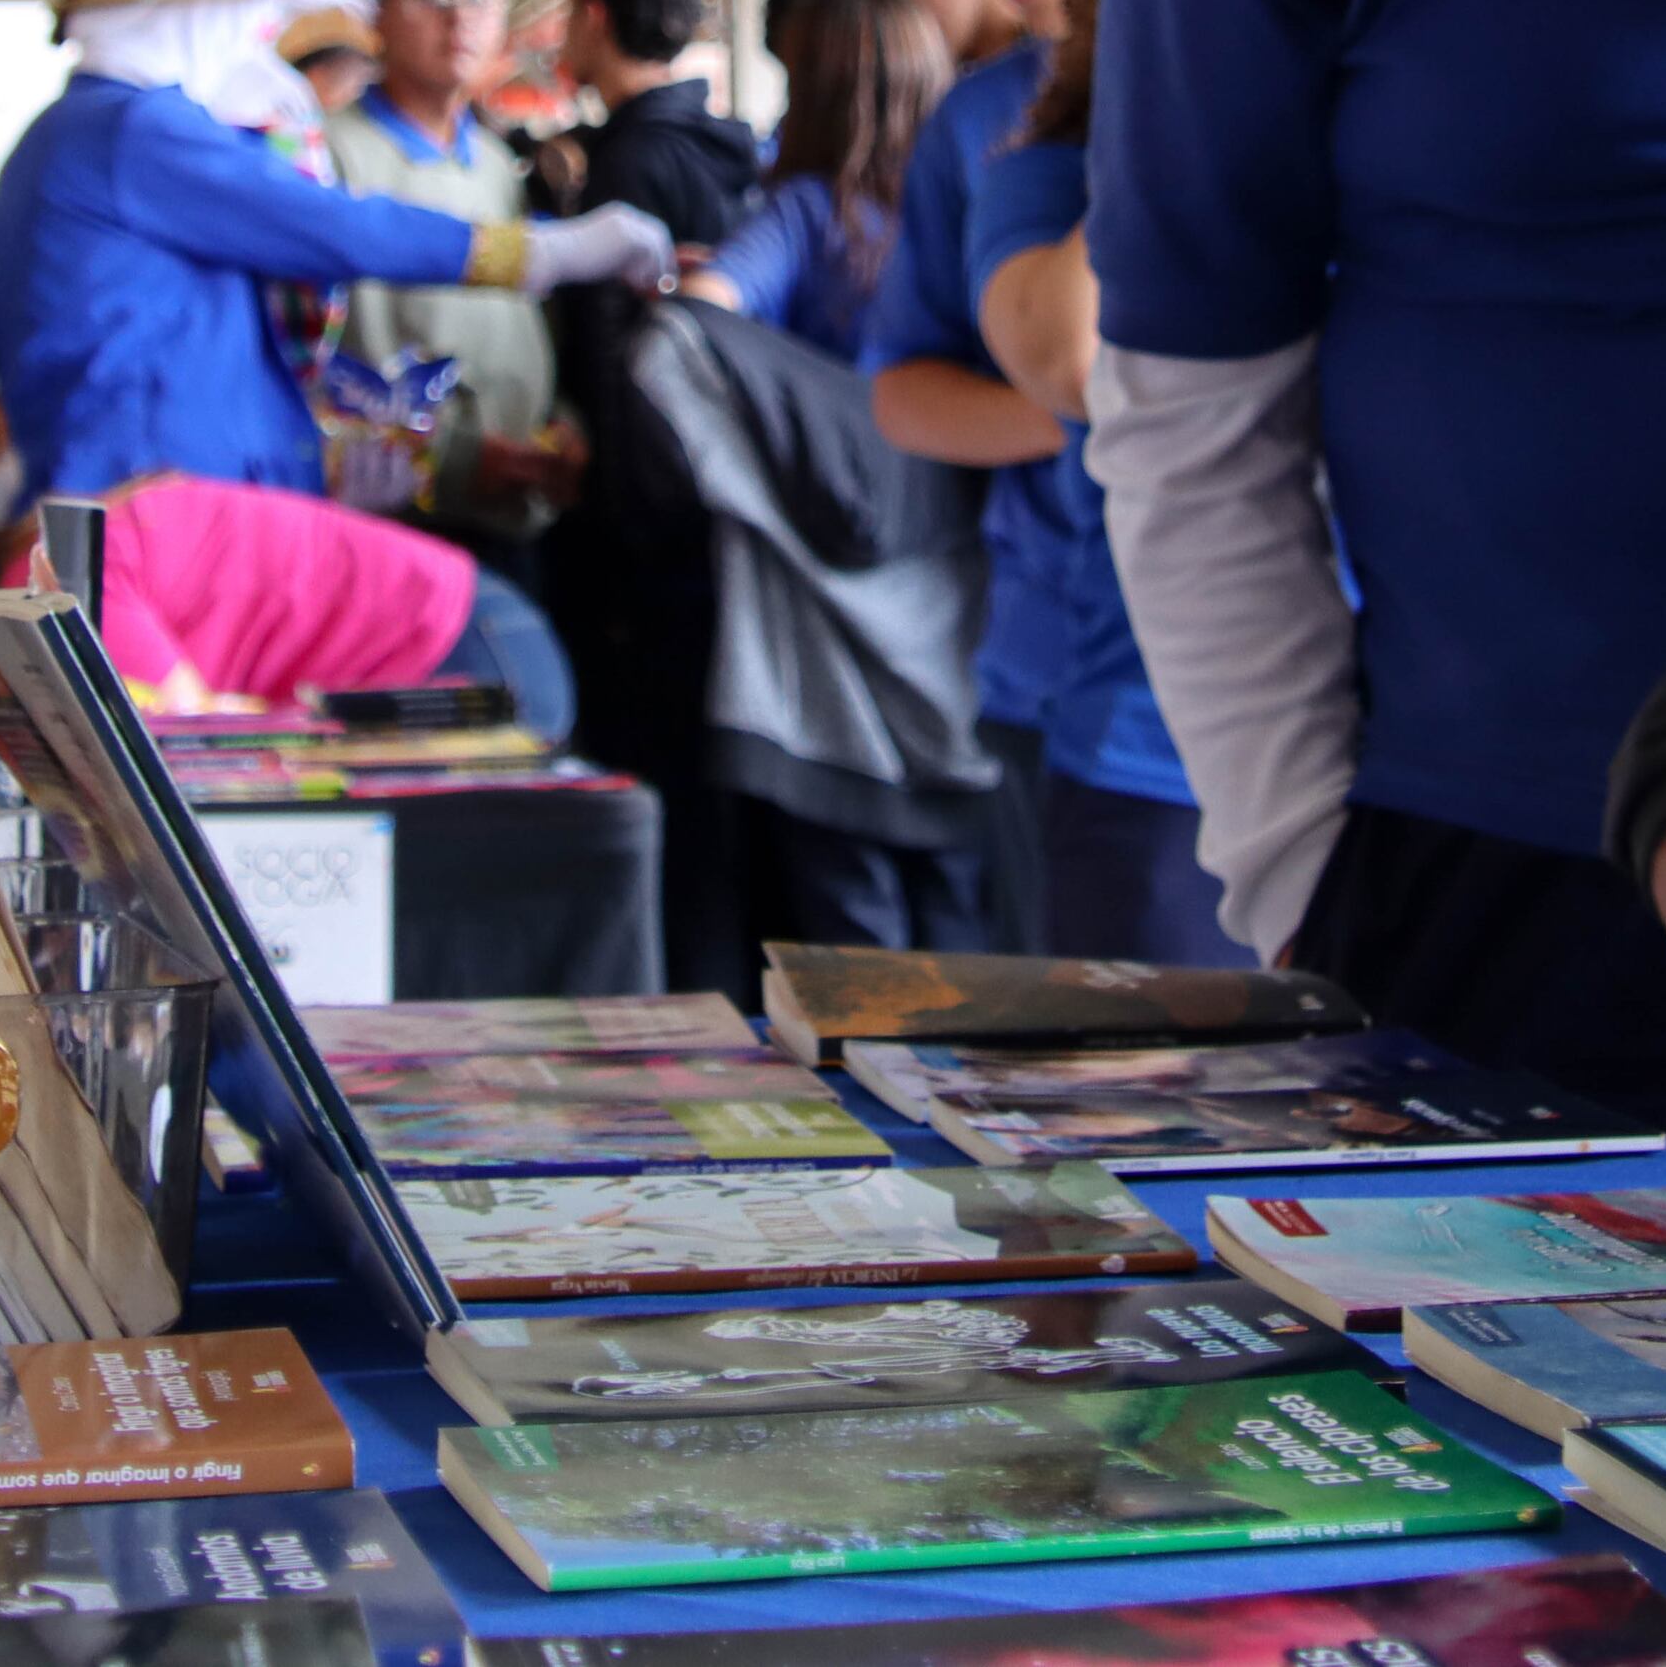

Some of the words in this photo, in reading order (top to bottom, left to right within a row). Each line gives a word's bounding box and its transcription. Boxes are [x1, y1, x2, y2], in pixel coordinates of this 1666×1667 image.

[89, 1352, 140, 1396] imaginar
[142, 1348, 191, 1376] tigres
[153, 1375, 199, 1408] somos
[104, 1405, 159, 1432] Fingir
[172, 1408, 219, 1430] que
[1267, 1393, 1379, 1455] cipreses
[1232, 1419, 1341, 1471] silencio
[43, 1465, 80, 1487] que
[85, 1463, 170, 1489] imaginar
[175, 1466, 188, 1481] o
[193, 1460, 242, 1485] Fingir
[1356, 1454, 1416, 1477] los
[1393, 1475, 1452, 1491] de
[251, 1536, 317, 1571] lluvia
[189, 1534, 269, 1601] Andamios
[273, 1571, 328, 1590] de
